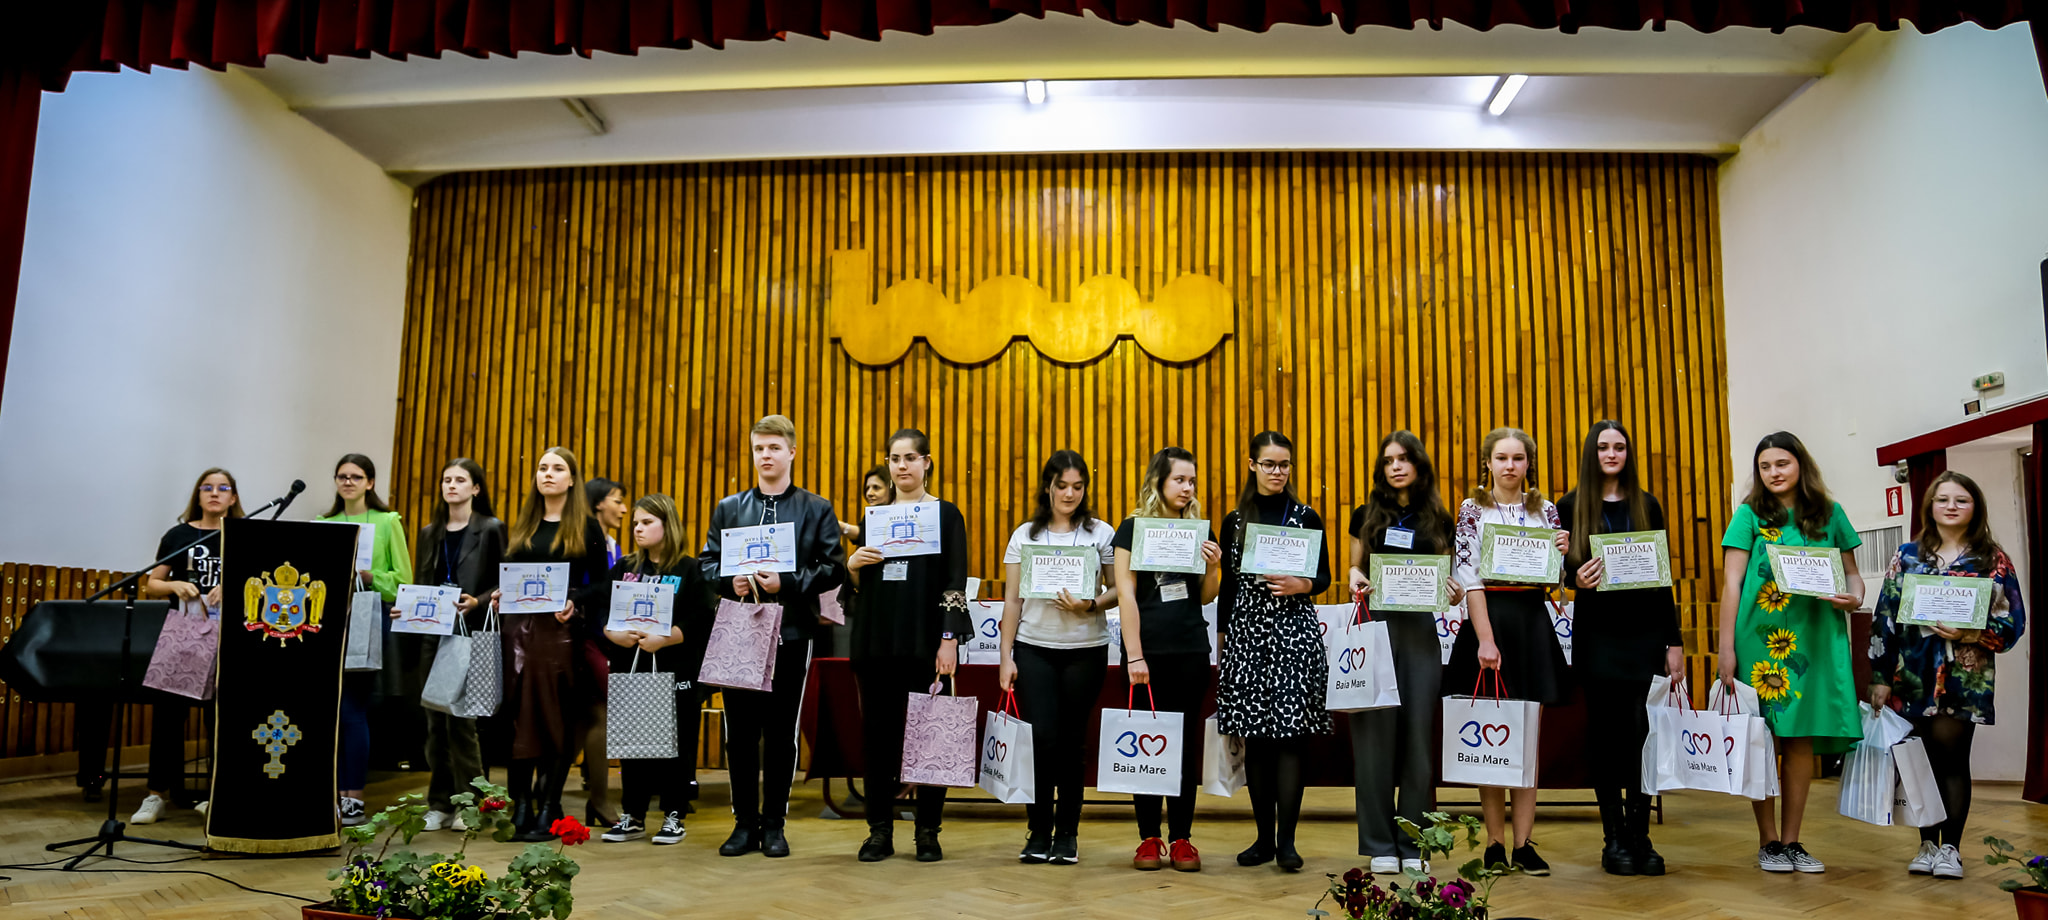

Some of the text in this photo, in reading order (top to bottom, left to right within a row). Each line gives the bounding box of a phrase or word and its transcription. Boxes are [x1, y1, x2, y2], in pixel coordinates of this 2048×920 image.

[1147, 530, 1194, 540] DIPLOMA
[1259, 535, 1306, 548] DIPLOMA
[1497, 537, 1547, 550] DIPLOMA
[1606, 544, 1653, 555] DIPLOMA
[1035, 556, 1082, 567] DIPLOMA
[1782, 556, 1829, 567] DIPLOMA
[1385, 567, 1435, 577] DIPLOMA
[1919, 586, 1973, 598] DIPLOMA
[979, 641, 998, 650] Baia
[674, 680, 692, 691] ASA
[1335, 679, 1367, 690] Baia Mare
[1457, 752, 1510, 766] Baia Mare
[1113, 762, 1167, 775] Baia Mare
[1700, 762, 1718, 773] Mare
[1894, 798, 1907, 807] are
